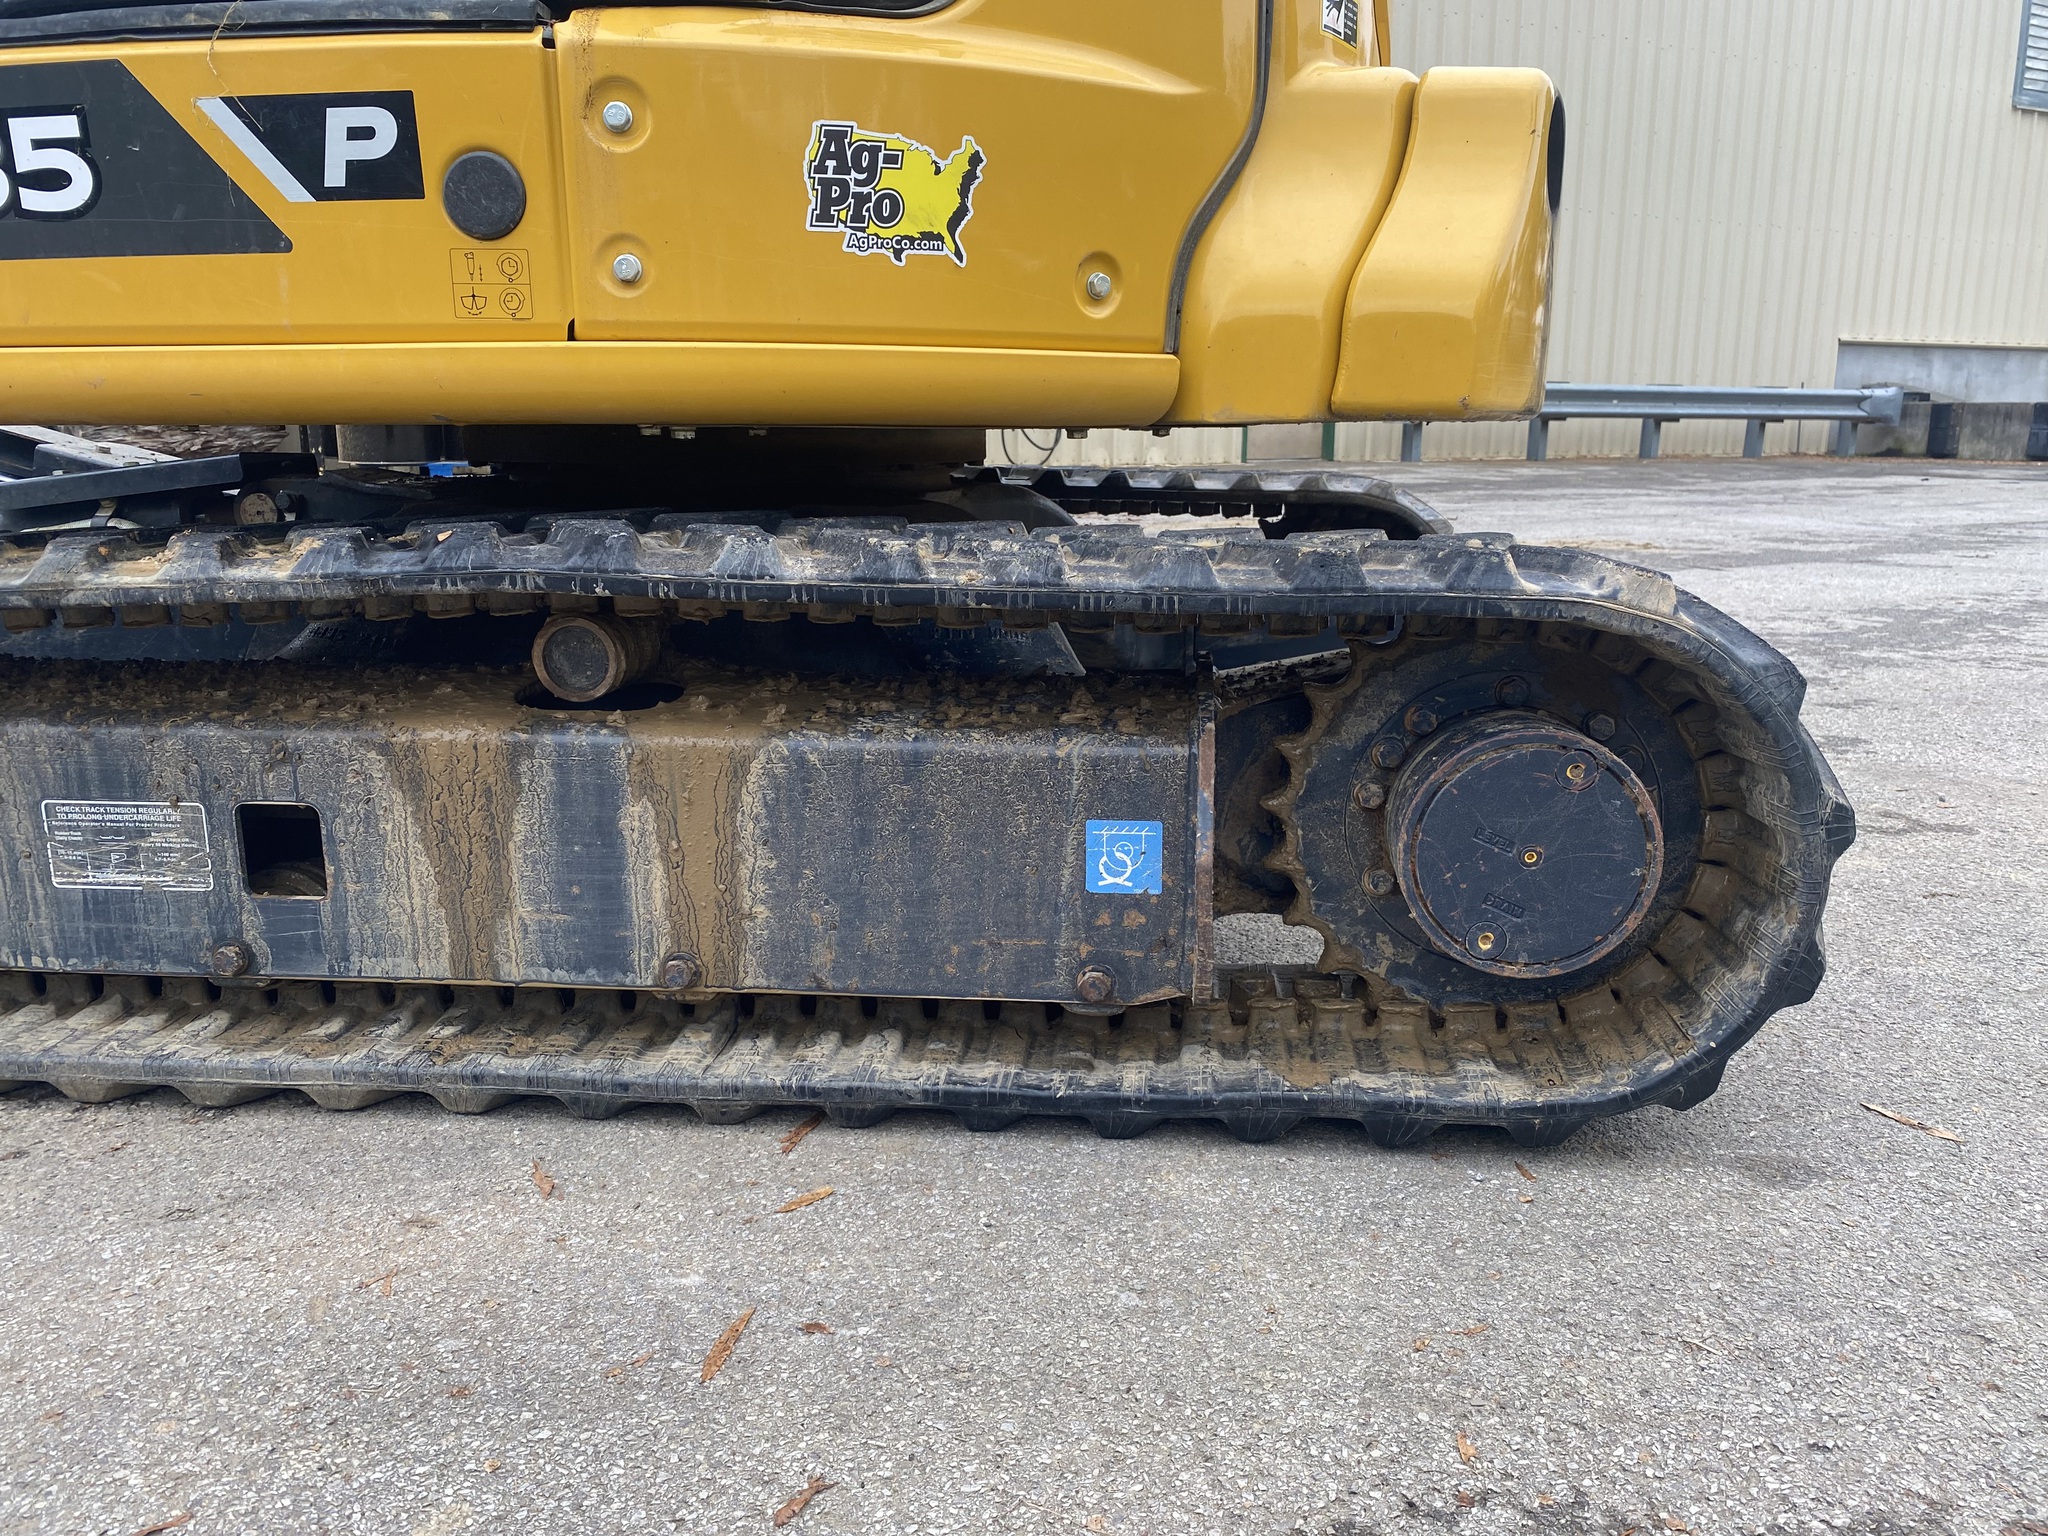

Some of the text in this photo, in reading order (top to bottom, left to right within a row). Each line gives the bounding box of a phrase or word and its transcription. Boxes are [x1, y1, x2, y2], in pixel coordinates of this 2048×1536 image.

[324, 106, 398, 188] P
[809, 124, 905, 188] Ag-
[0, 115, 93, 212] 5
[810, 177, 905, 230] Pro
[847, 234, 945, 252] AgProCo.com
[68, 813, 102, 821] PROLONG
[103, 814, 165, 822] UNDERCARRIAGE
[105, 806, 138, 814] TENSION
[1475, 828, 1513, 853] LEVEL
[1486, 894, 1523, 918] DRAIN
